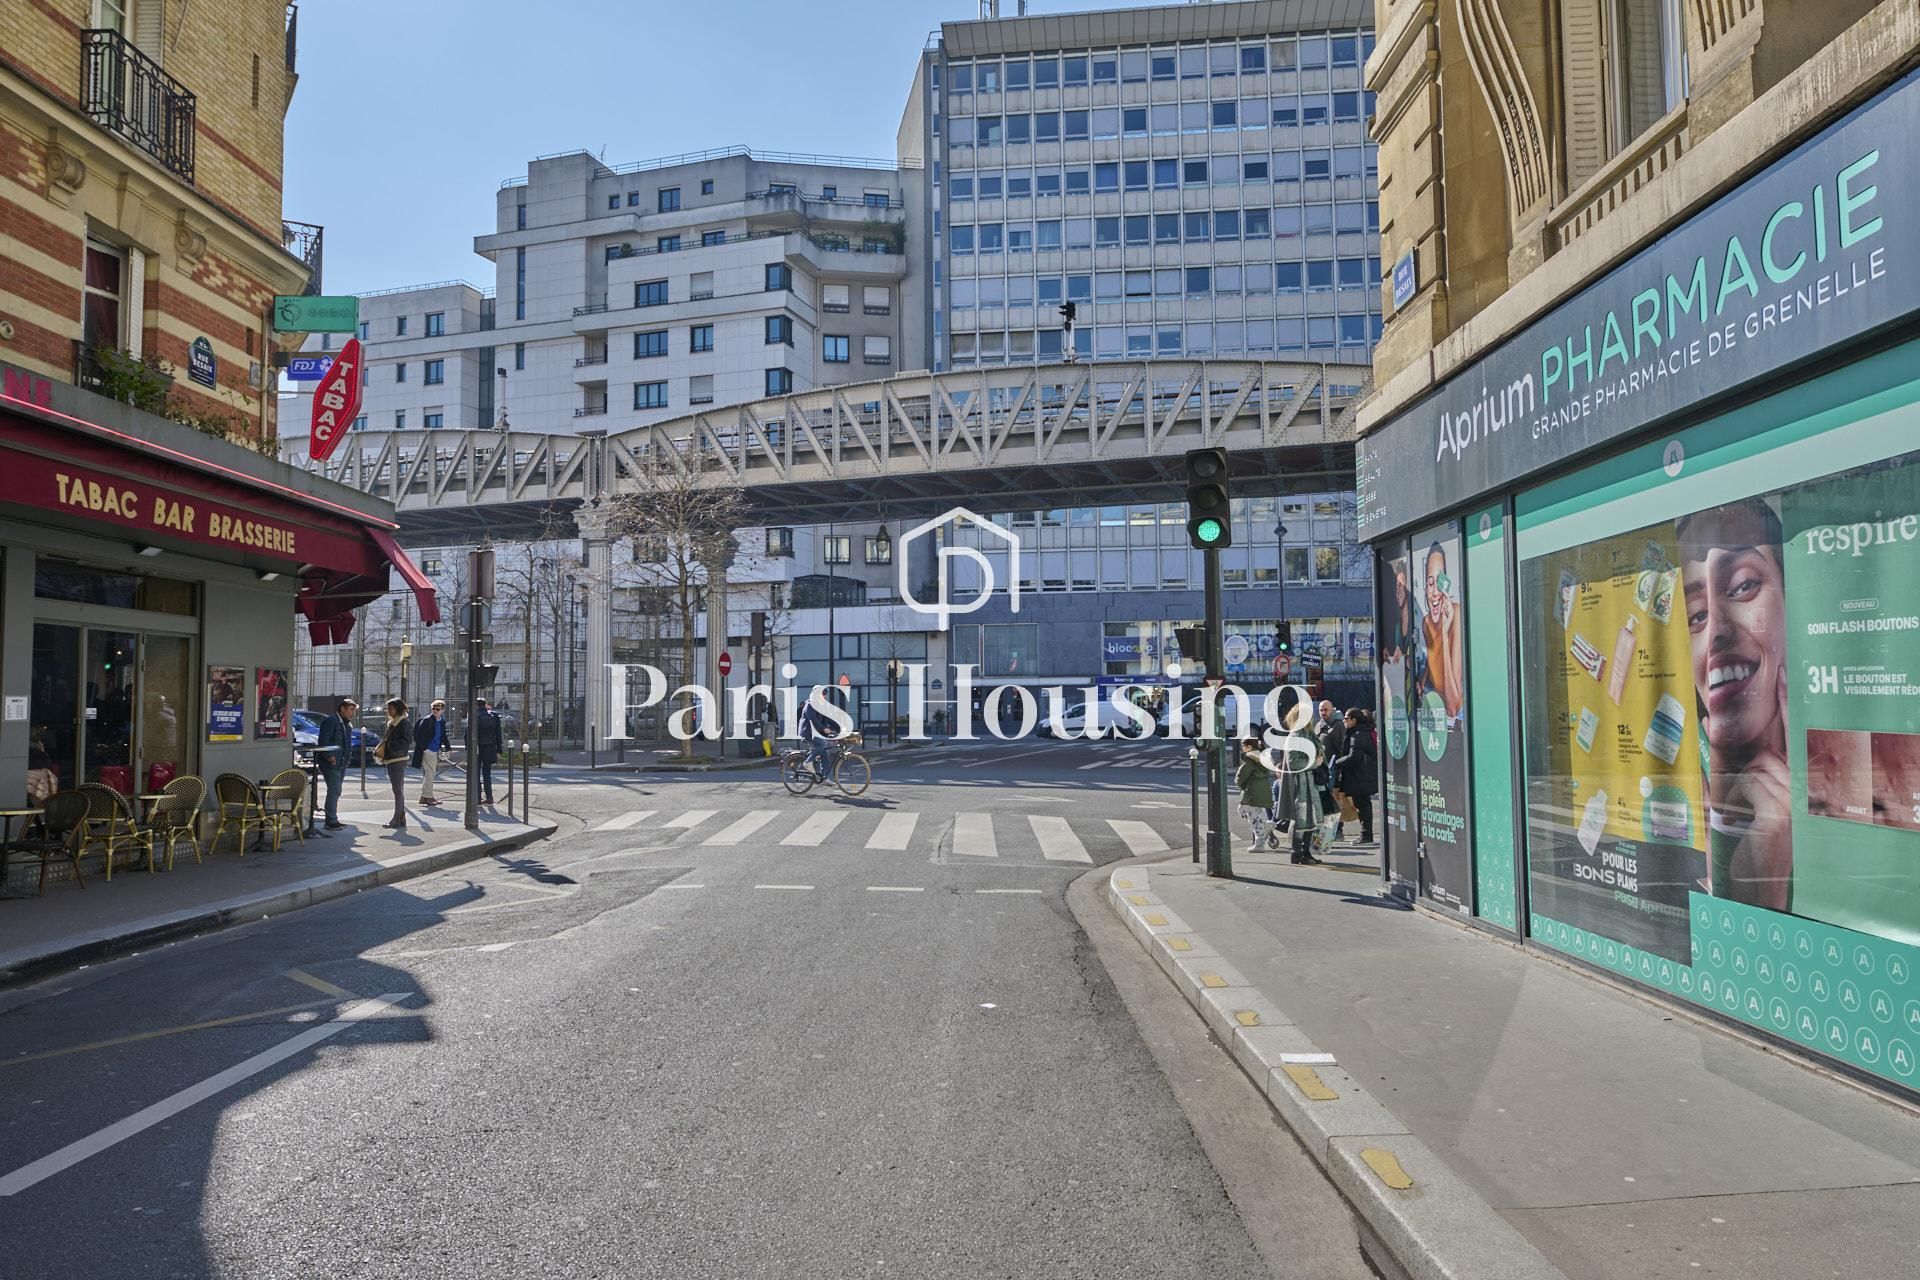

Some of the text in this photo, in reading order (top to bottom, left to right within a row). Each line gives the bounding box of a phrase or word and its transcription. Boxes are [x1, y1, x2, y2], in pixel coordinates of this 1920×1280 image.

[1436, 148, 1884, 462] Aprium PHARMACIE
[1531, 247, 1887, 440] GRANDE PHARMACIE DE GRENELLE
[293, 361, 316, 371] FDJ
[314, 360, 353, 442] TABAC
[55, 473, 296, 555] TABAC BAR BRASSERIE
[1806, 510, 1918, 557] respire
[1843, 600, 1875, 610] NOUVEAU
[1807, 615, 1919, 635] SOIN FLASH BOUTONS
[1807, 665, 1839, 694] 3H
[1843, 673, 1907, 684] LE BOUTON EST
[1844, 683, 1920, 695] VISIBLEMENT RÉD
[1428, 732, 1440, 751] A+
[1420, 775, 1440, 791] Faites
[1421, 790, 1445, 809] le plein
[1846, 805, 1868, 815] AVANT
[1422, 807, 1465, 830] d'avantages
[1422, 822, 1457, 844] à la carte.
[1602, 852, 1638, 874] POUR LES
[1573, 863, 1638, 893] BONS PLANS
